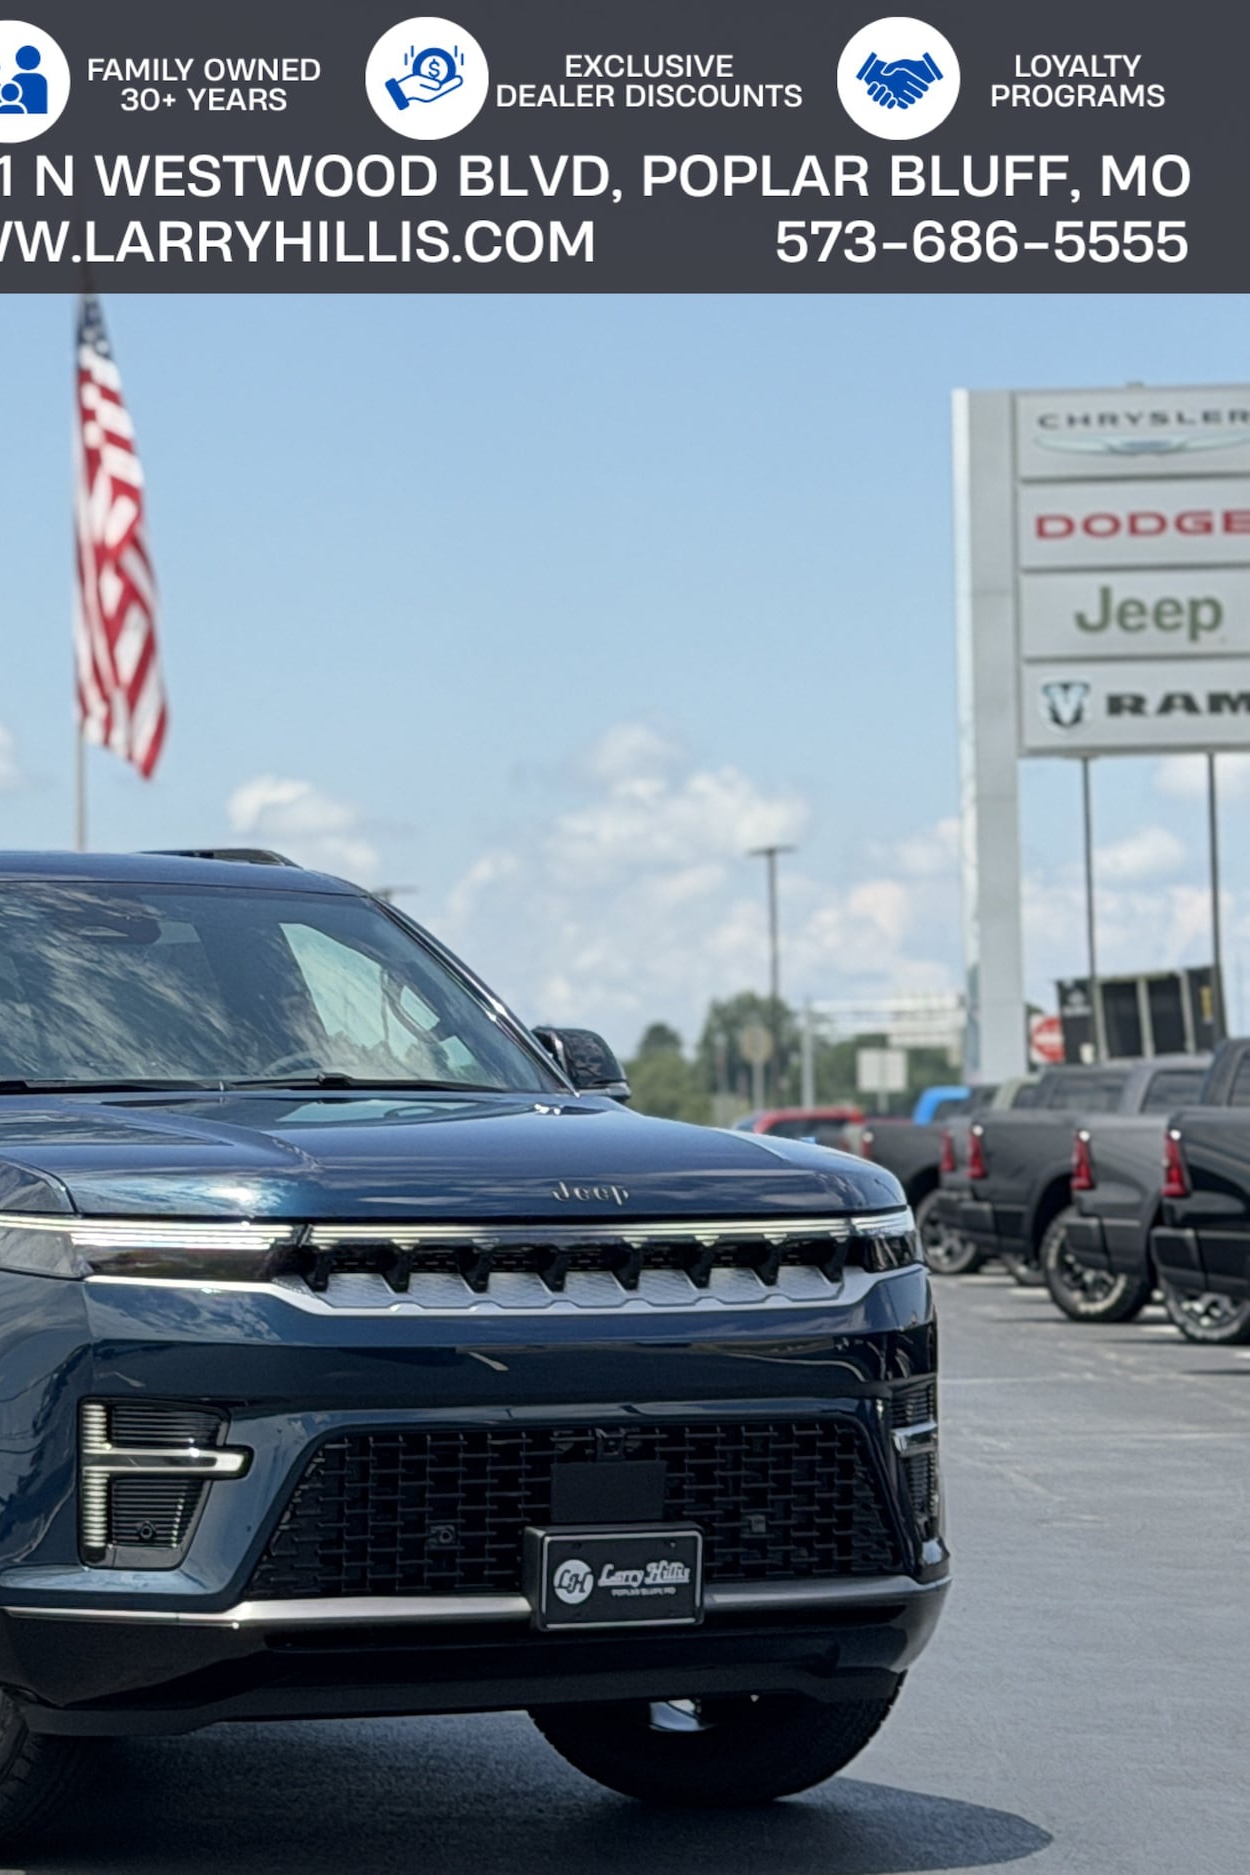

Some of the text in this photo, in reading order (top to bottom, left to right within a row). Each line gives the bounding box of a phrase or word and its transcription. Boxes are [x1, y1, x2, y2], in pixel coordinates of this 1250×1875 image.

[1037, 409, 1250, 430] CHRYSLER
[1035, 510, 1250, 540] DODGE
[1074, 585, 1224, 643] Jeep
[1105, 692, 1250, 717] RAM
[552, 1181, 629, 1206] Jeep
[598, 1560, 690, 1588] Larry Hillis
